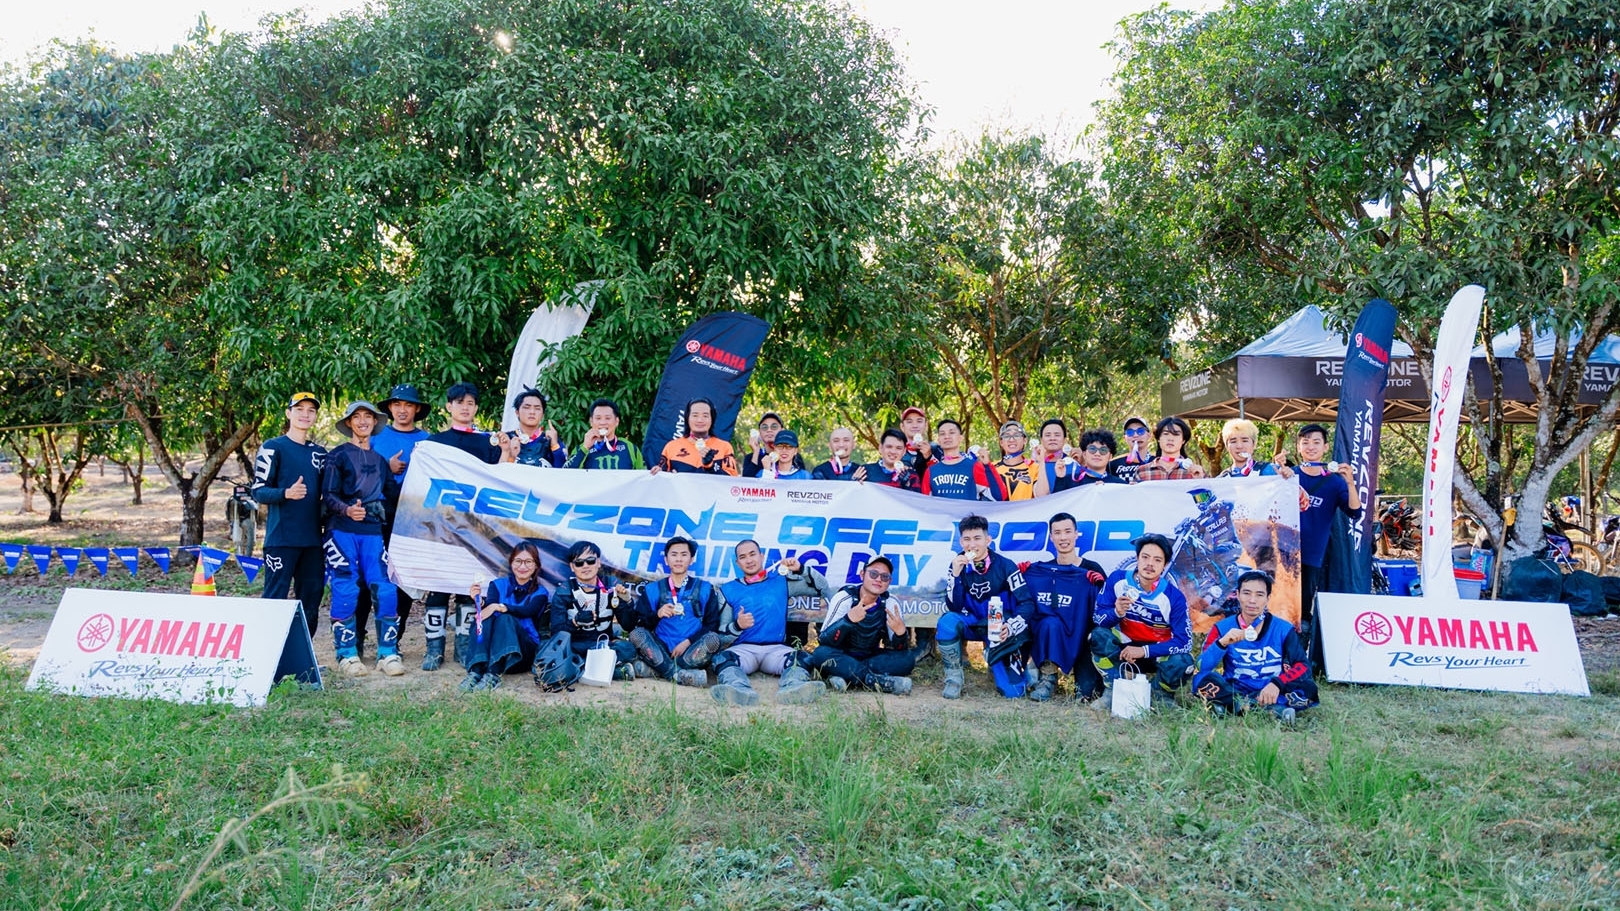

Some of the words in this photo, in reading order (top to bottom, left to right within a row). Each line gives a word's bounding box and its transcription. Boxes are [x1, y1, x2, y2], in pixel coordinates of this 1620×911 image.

[699, 342, 747, 372] YAMAHA
[1316, 360, 1420, 376] RENE
[1386, 378, 1411, 387] TOR
[932, 473, 955, 487] TROY
[955, 474, 969, 486] LEE
[741, 487, 776, 498] YAMAHA
[787, 490, 833, 500] REVZONE
[115, 617, 245, 660] YAMAHA
[1394, 615, 1539, 652] YAMAHA
[1387, 651, 1442, 668] Revs
[1444, 656, 1484, 670] Your
[1484, 656, 1527, 667] Heart
[89, 660, 144, 678] Revs
[144, 664, 181, 681] Your
[178, 664, 225, 676] Heart
